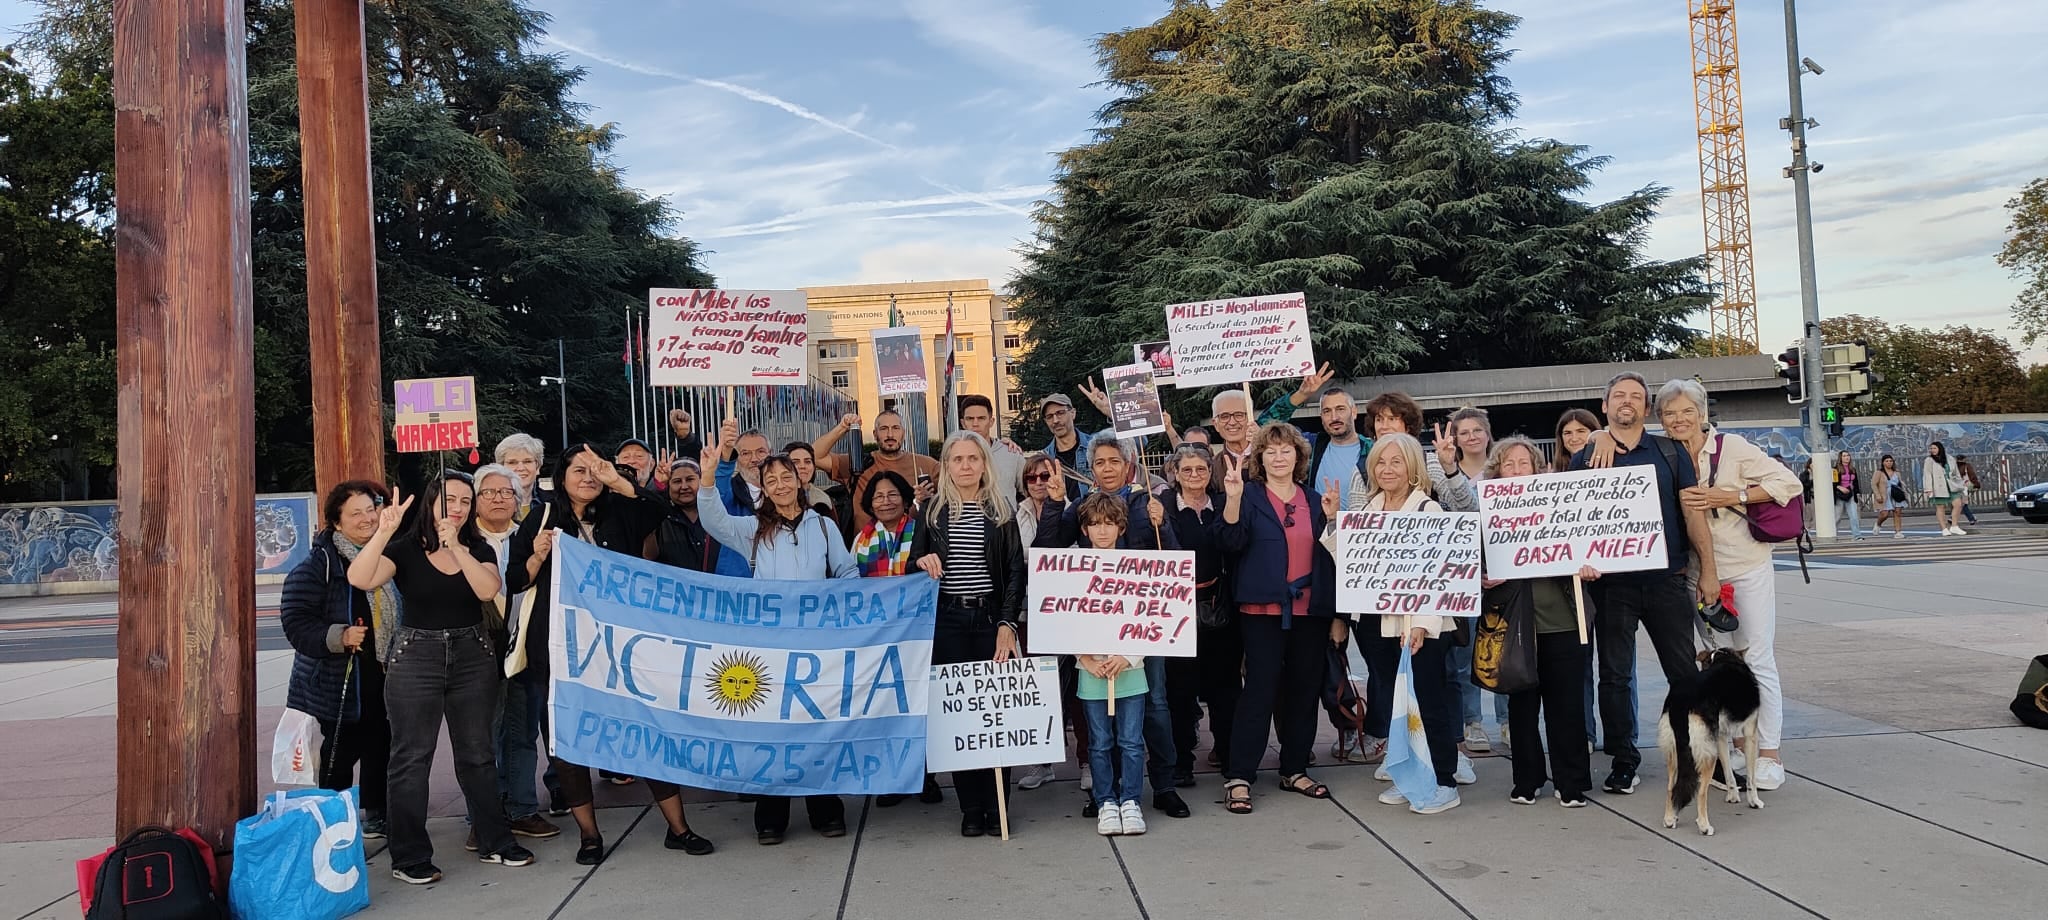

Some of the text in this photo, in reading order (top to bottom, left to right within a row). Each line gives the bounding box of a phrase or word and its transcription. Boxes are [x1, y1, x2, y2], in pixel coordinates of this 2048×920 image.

[745, 294, 771, 309] los
[1233, 318, 1247, 328] des
[692, 324, 808, 347] tienen hambre
[1191, 338, 1242, 355] protection
[1244, 337, 1262, 347] des
[1263, 336, 1289, 346] lieux
[1291, 335, 1303, 343] de
[668, 335, 680, 352] 7
[678, 340, 696, 350] de
[697, 340, 726, 351] cada
[725, 340, 744, 355] 10
[751, 344, 781, 358] son
[1233, 350, 1250, 358] en
[658, 352, 712, 370] pobres
[396, 379, 471, 413] MILEI
[1115, 400, 1140, 413] 52%
[397, 421, 475, 452] HAMBRE
[1483, 482, 1524, 499] Basta
[1611, 476, 1620, 487] a
[1623, 472, 1646, 486] los
[1552, 495, 1560, 509] y
[1564, 490, 1579, 503] el
[1584, 486, 1637, 501] Pueblo
[1390, 514, 1451, 533] réprime
[1455, 515, 1477, 531] les
[1488, 504, 1630, 532] Respeto total de los
[1427, 530, 1445, 545] et
[1447, 530, 1474, 545] les
[1489, 529, 1531, 544] DDHH
[1568, 521, 1625, 541] personas
[1346, 545, 1479, 563] richesses du pays
[1514, 543, 1573, 567] BASTA
[1345, 561, 1382, 574] sont
[1384, 562, 1420, 577] pour
[1422, 560, 1437, 574] le
[578, 558, 935, 628] ARGENTINOS PARA LA
[1345, 575, 1451, 591] et les riches
[1039, 596, 1174, 618] ENTREGA DEL
[1375, 592, 1480, 613] STOP Milei
[945, 680, 965, 696] LA
[942, 691, 1047, 714] NO SE VENDE,
[982, 712, 1004, 728] SE
[573, 711, 740, 777] PROVINCIA
